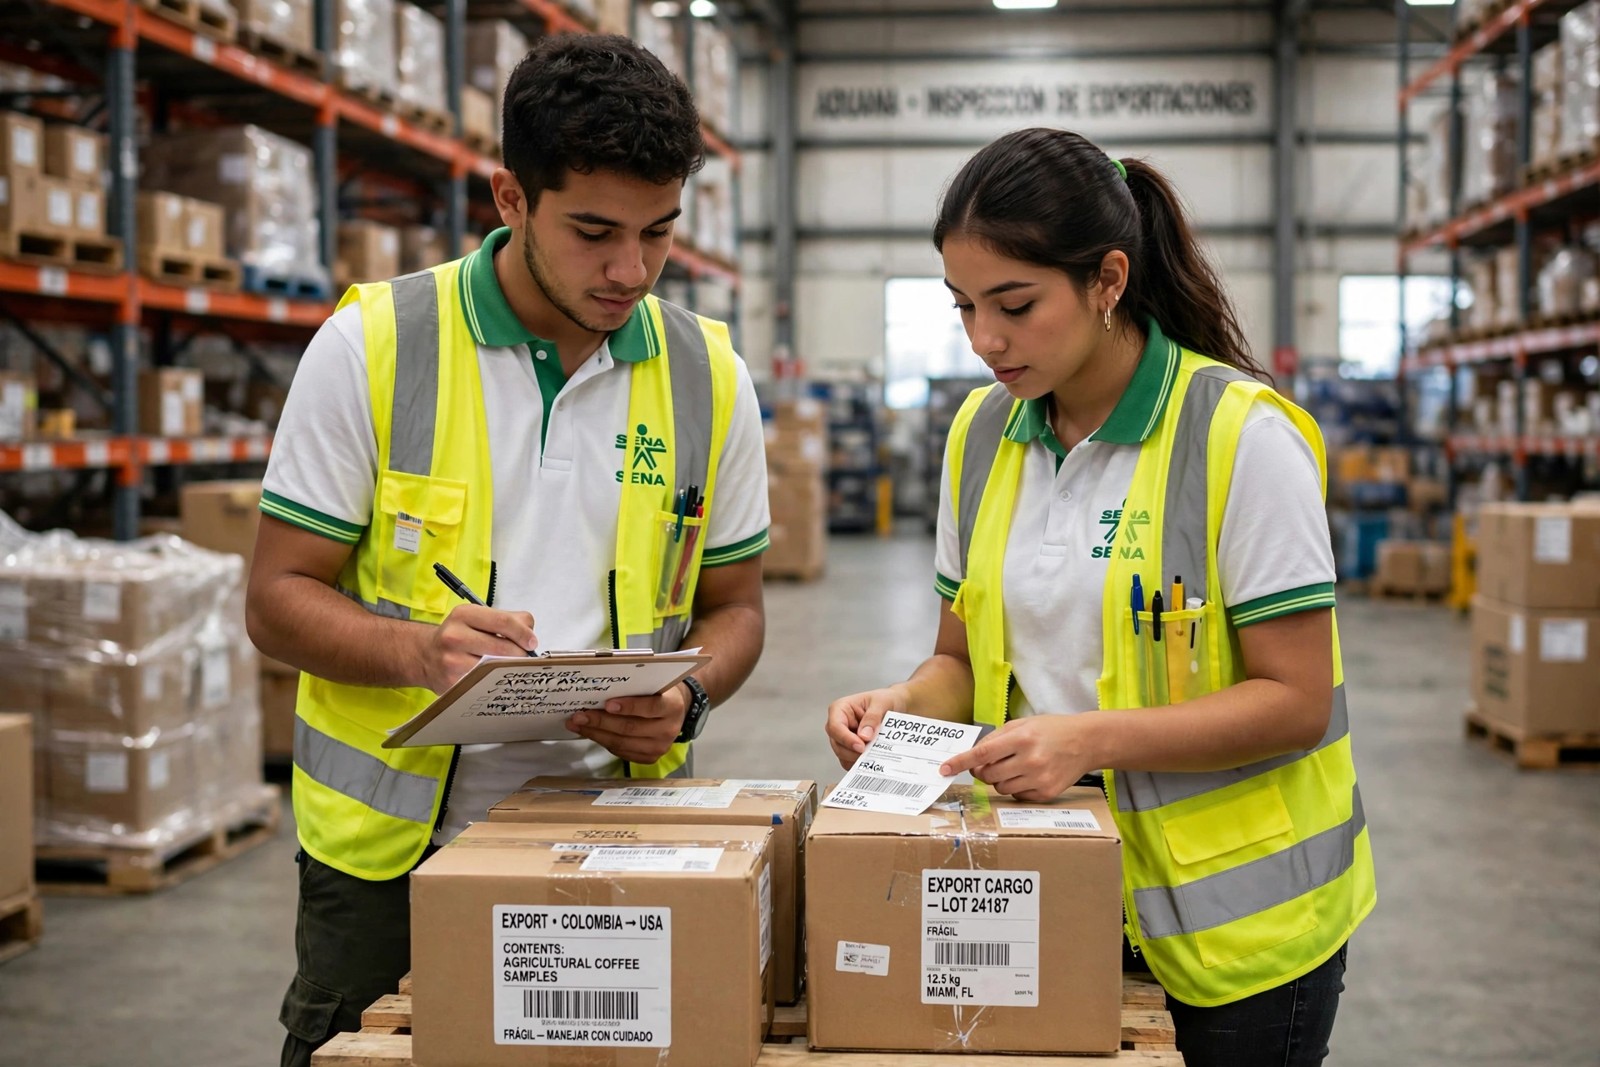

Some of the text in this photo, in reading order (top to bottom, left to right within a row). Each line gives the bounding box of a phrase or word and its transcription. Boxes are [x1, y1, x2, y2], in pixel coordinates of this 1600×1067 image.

[615, 434, 665, 448] SENA
[615, 470, 666, 486] SENA
[1091, 546, 1145, 560] SENA
[503, 670, 581, 679] CHECKLIST
[495, 678, 554, 687] EXPORT
[884, 717, 965, 740] EXPORT CARGO
[906, 733, 940, 747] 24187
[928, 877, 1033, 894] EXPORT CARGO
[941, 897, 968, 912] LOT
[971, 898, 1009, 913] 24187
[501, 913, 664, 931] EXPORT COLOMBIA USA
[503, 943, 565, 955] CONTENTS:
[503, 957, 640, 970] AGRICULTURAL COFFEE
[503, 971, 558, 982] SAMPLES
[926, 973, 961, 987] 12.5 kg
[926, 986, 974, 999] MIAMI, FL
[503, 1027, 536, 1040] FRÁGIL
[546, 1030, 589, 1041] MANEJAR
[590, 1031, 610, 1041] CON
[612, 1031, 653, 1042] CUIDADO
